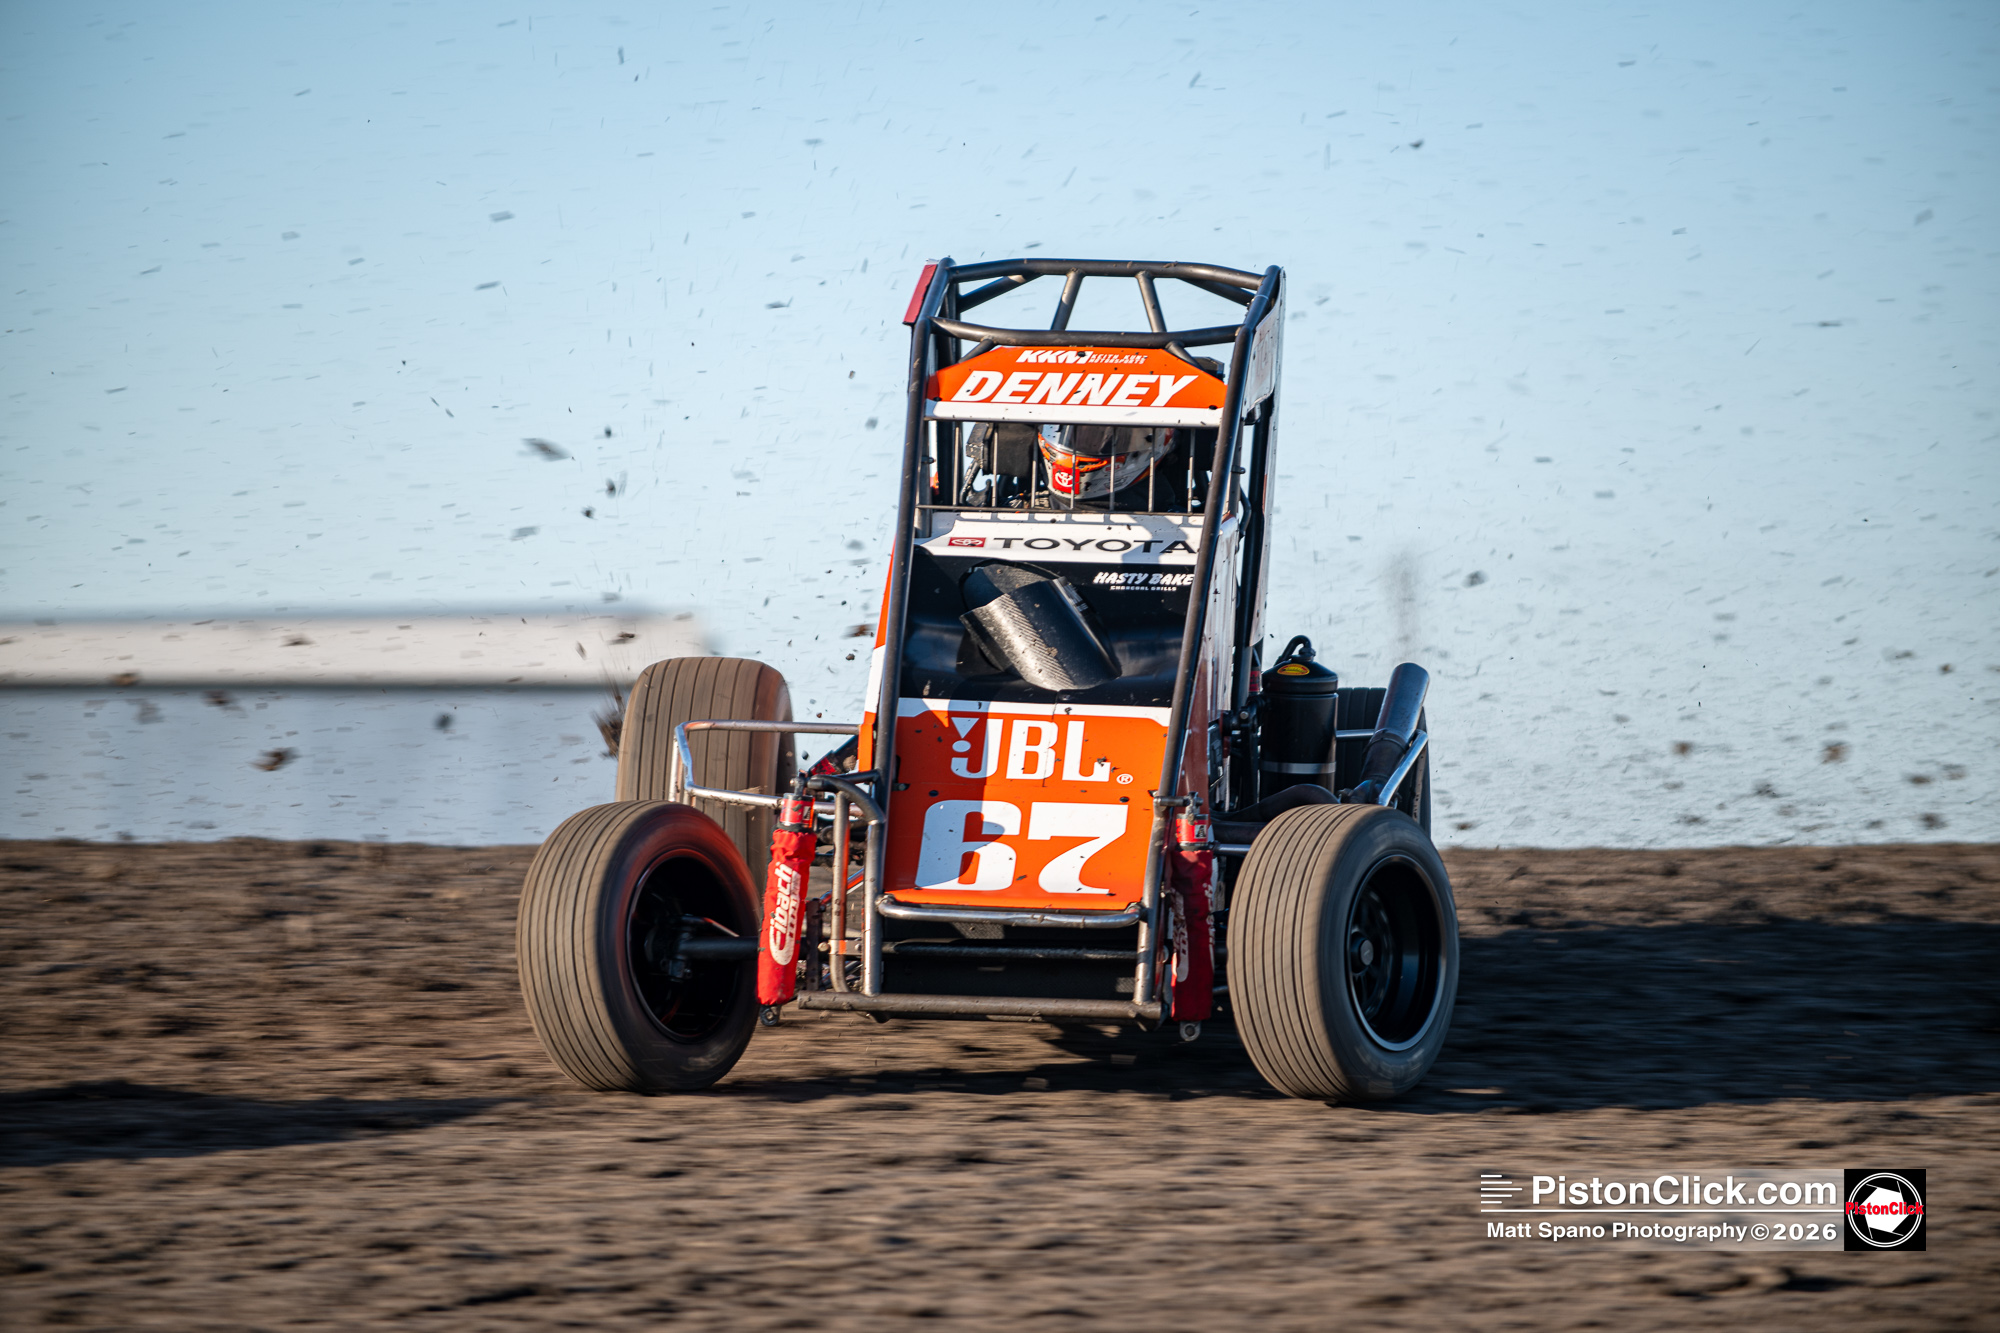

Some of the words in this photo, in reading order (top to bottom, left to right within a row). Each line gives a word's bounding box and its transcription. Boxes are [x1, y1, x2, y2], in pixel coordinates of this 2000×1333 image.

[950, 370, 1198, 407] DENNEY
[993, 537, 1196, 554] TOYOTA
[1092, 572, 1149, 584] HASTY
[950, 717, 1112, 783] JBL
[914, 799, 1129, 895] 67
